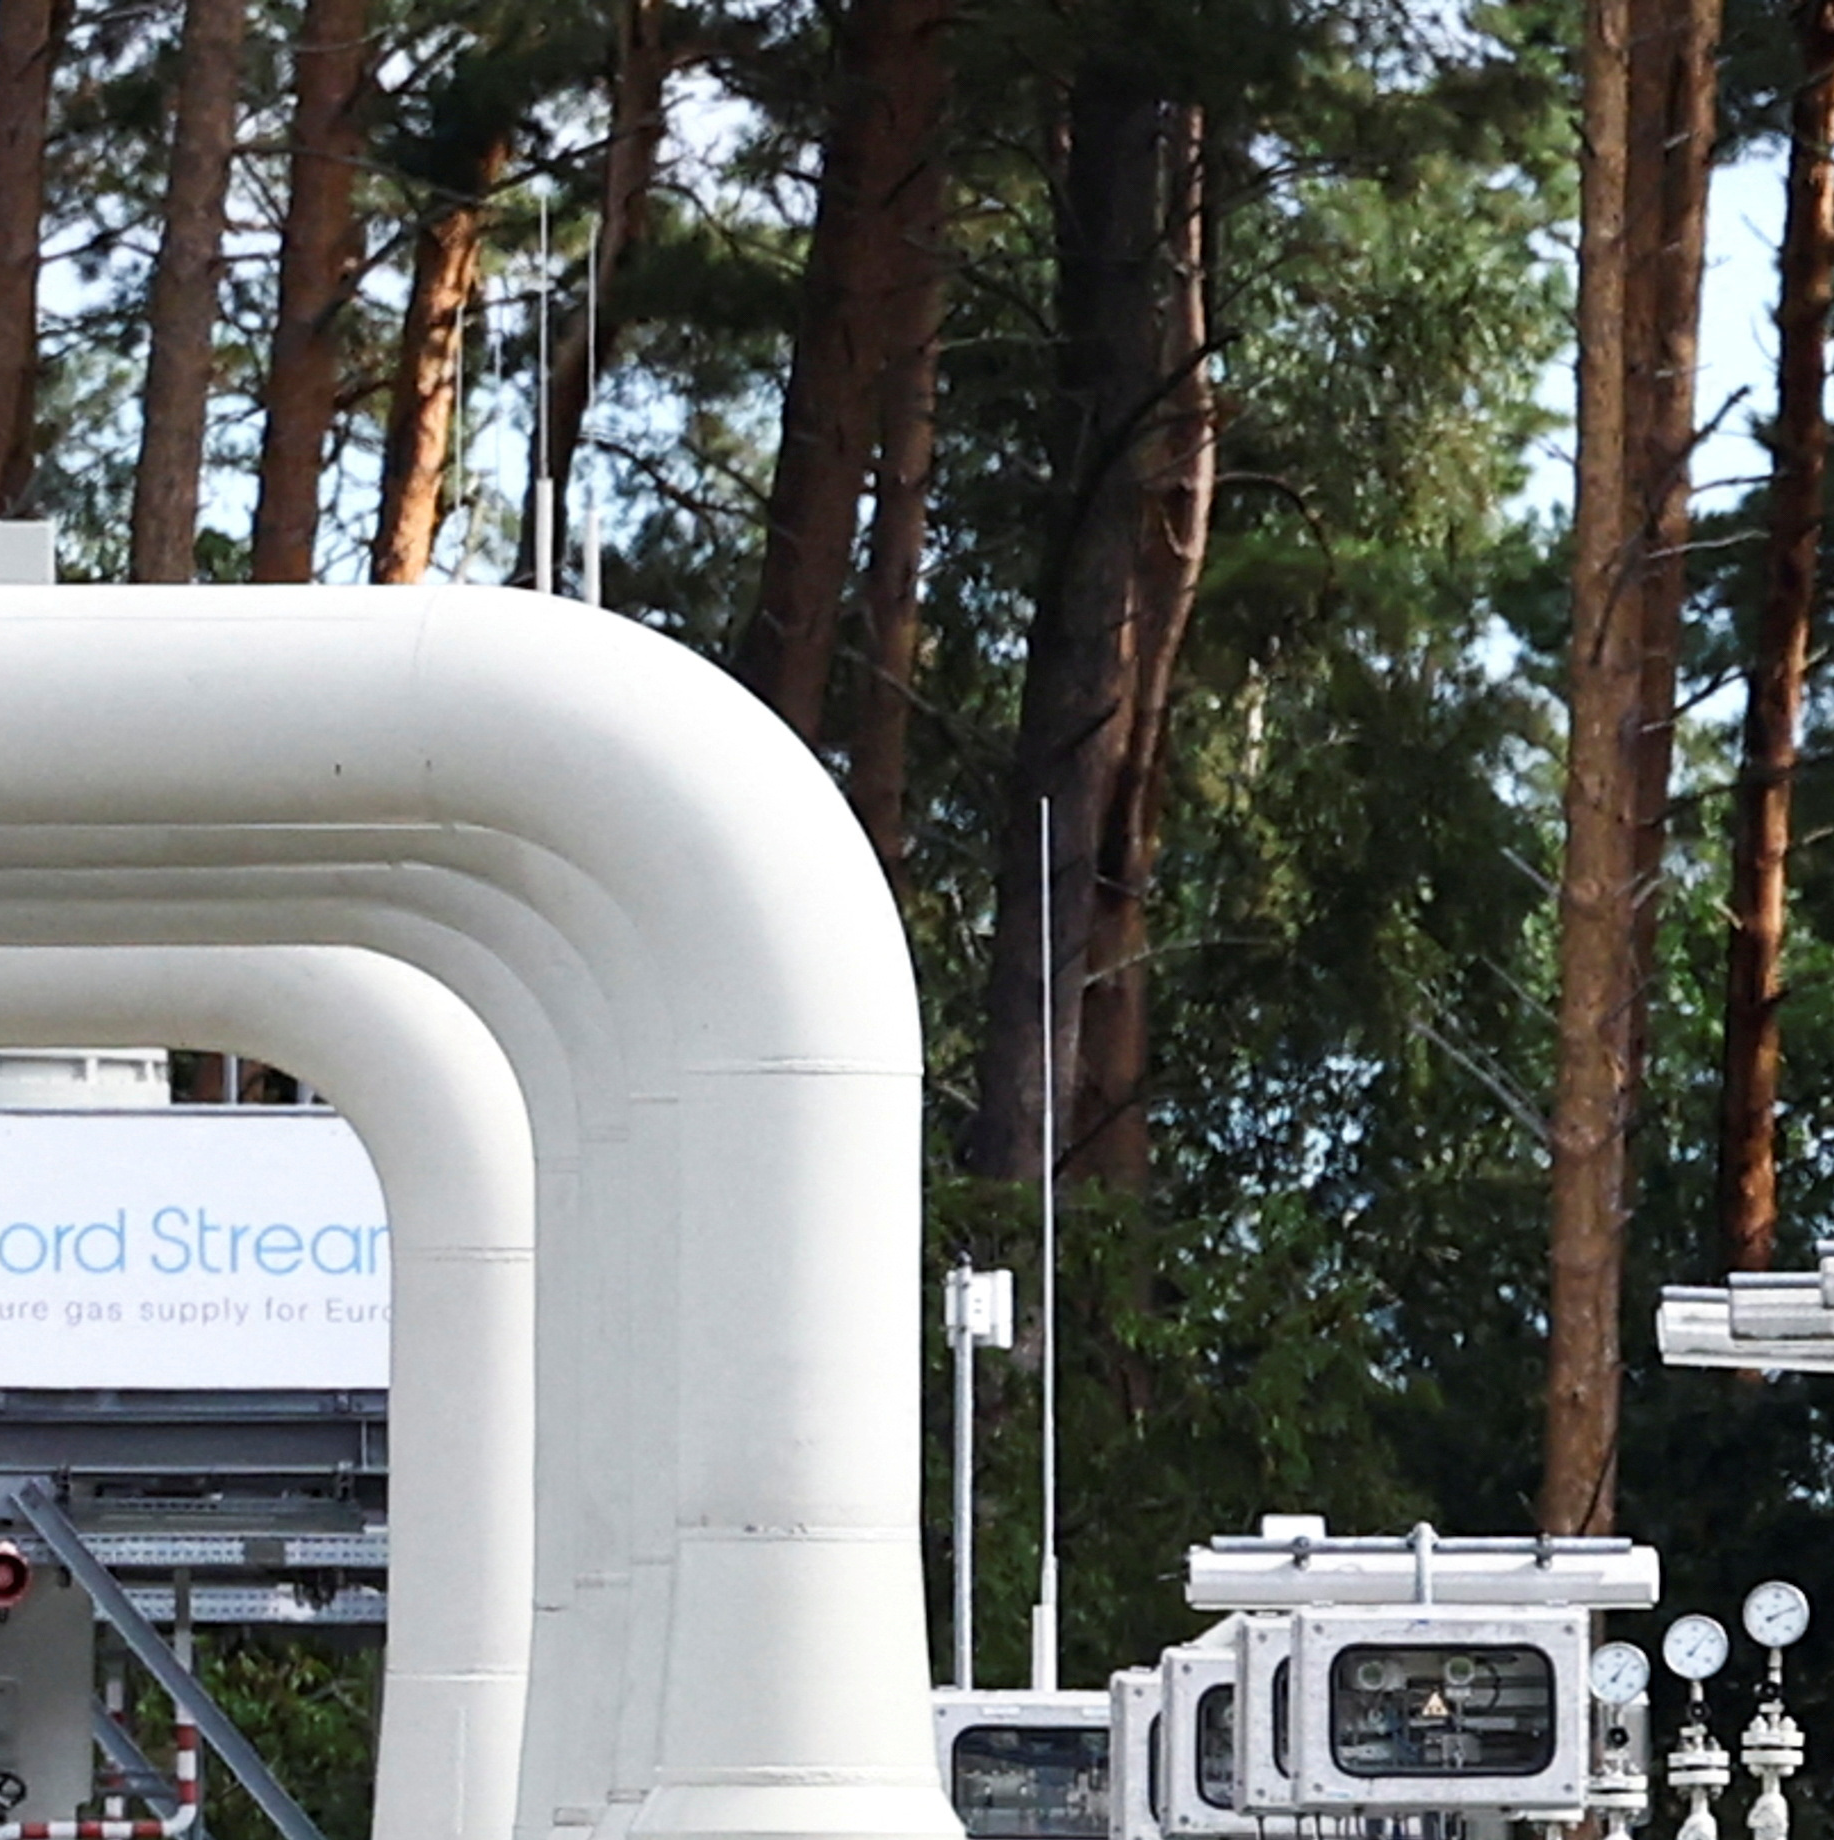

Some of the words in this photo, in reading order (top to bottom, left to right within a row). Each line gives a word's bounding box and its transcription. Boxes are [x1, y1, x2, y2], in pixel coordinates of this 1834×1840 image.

[65, 1300, 123, 1326] gas
[140, 1297, 249, 1326] supply
[265, 1296, 308, 1322] for
